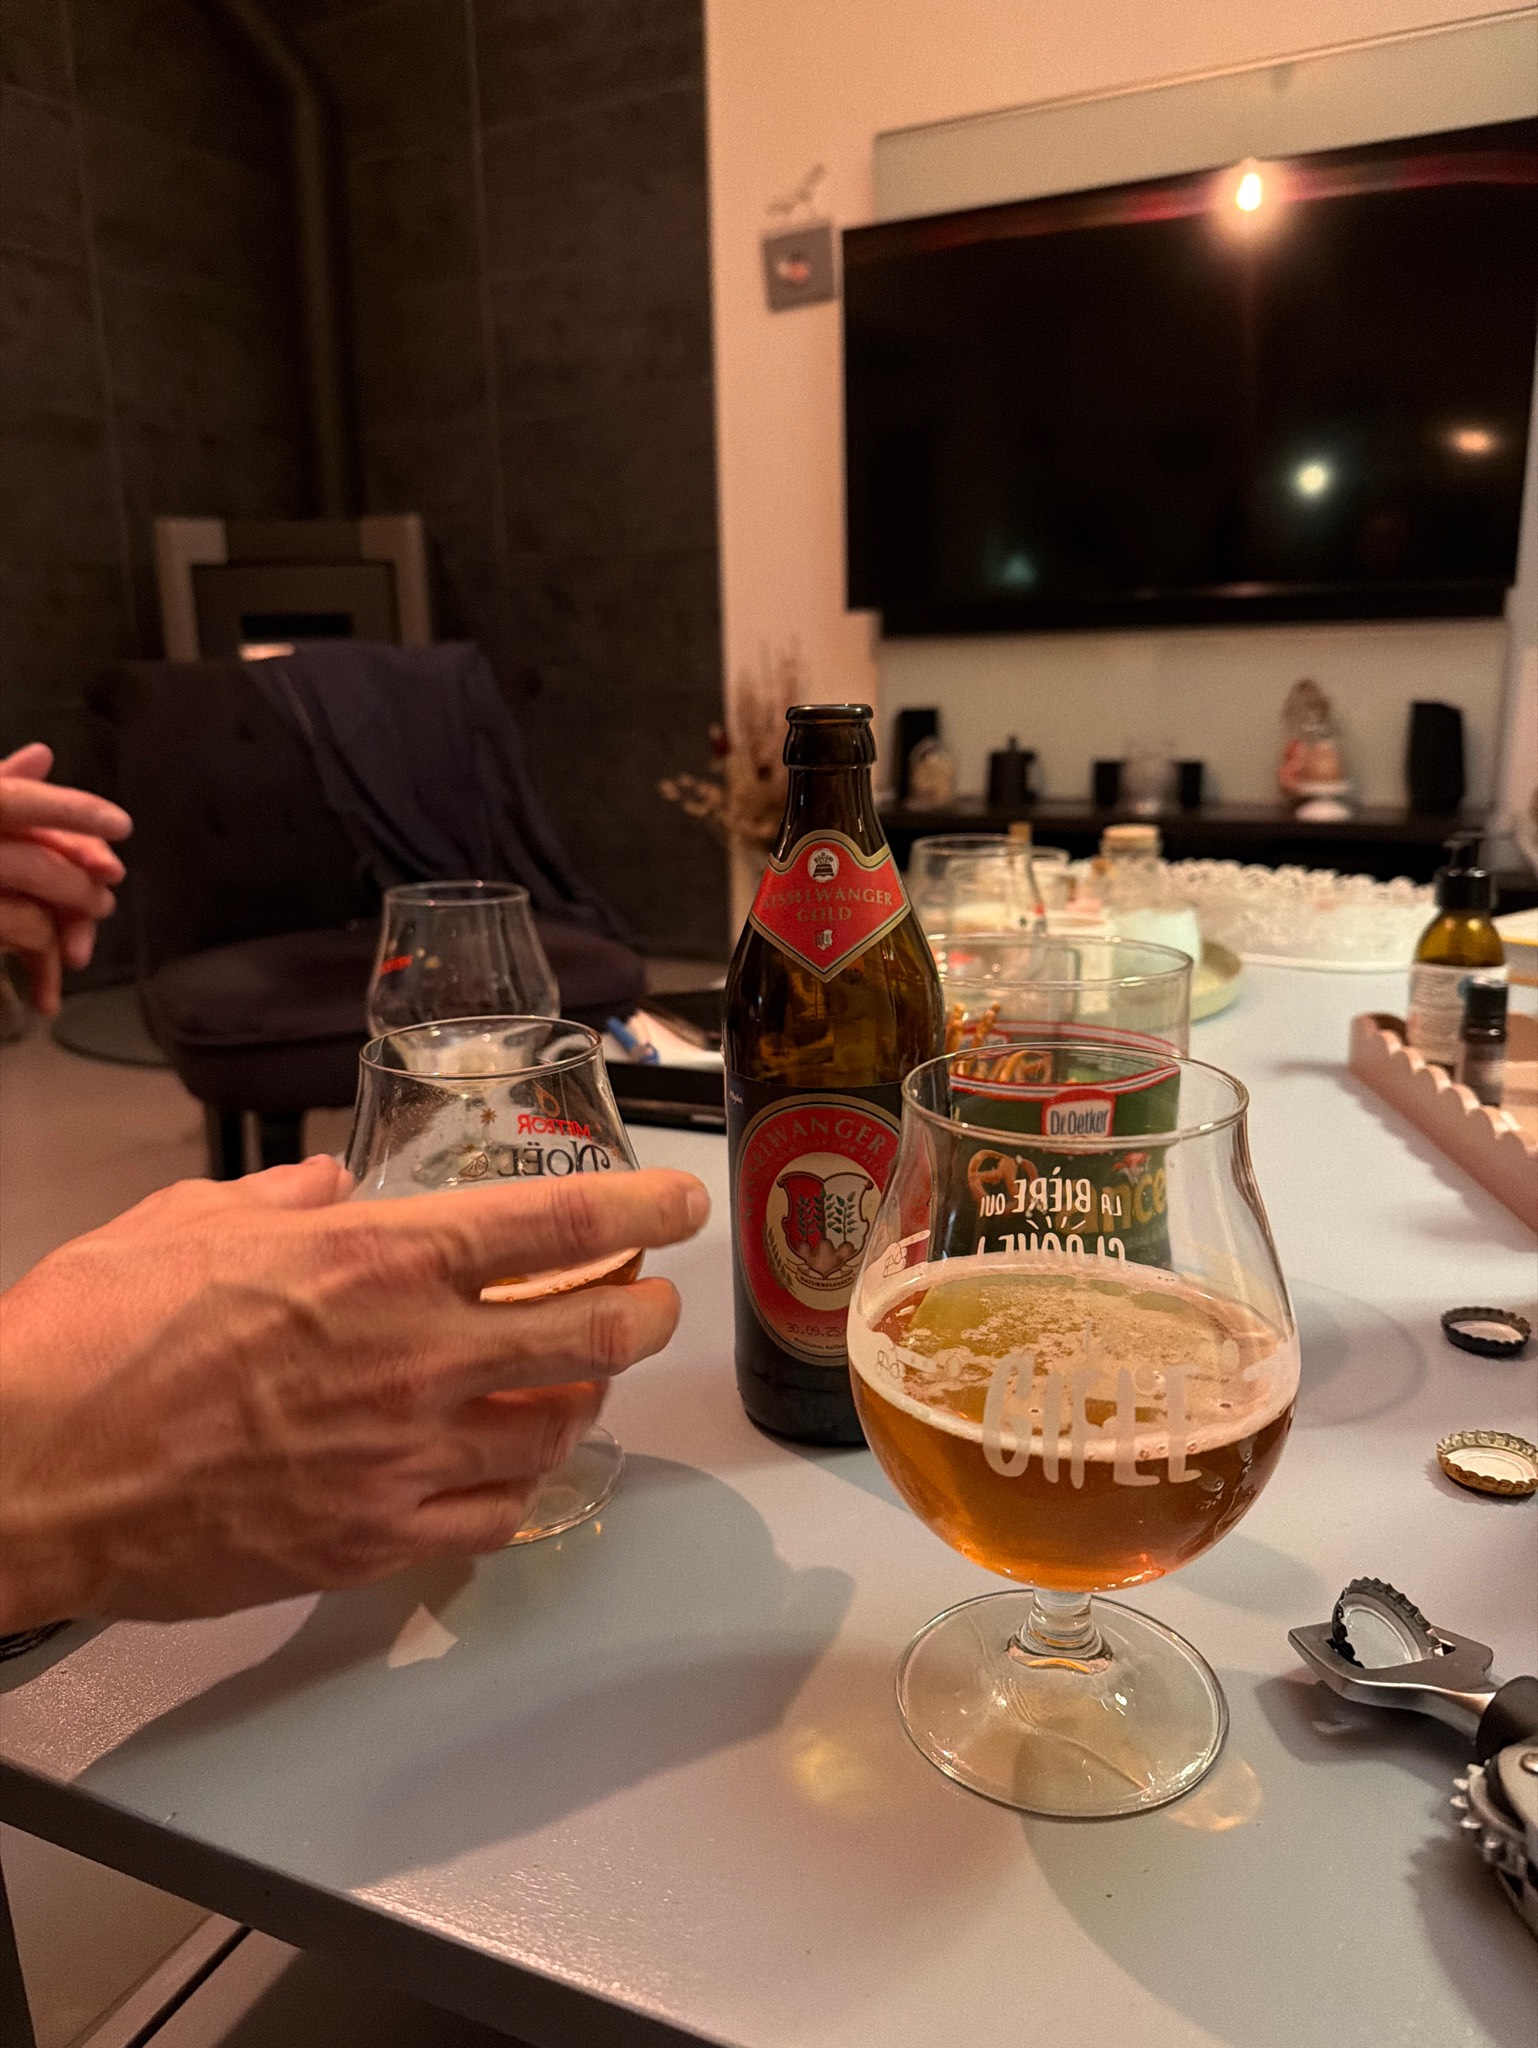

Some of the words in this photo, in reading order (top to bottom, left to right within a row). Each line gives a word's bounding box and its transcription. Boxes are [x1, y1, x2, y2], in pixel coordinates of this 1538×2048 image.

[796, 905, 852, 923] GOLD
[1067, 1108, 1110, 1135] Oetker
[785, 1322, 842, 1338] 30.09.25
